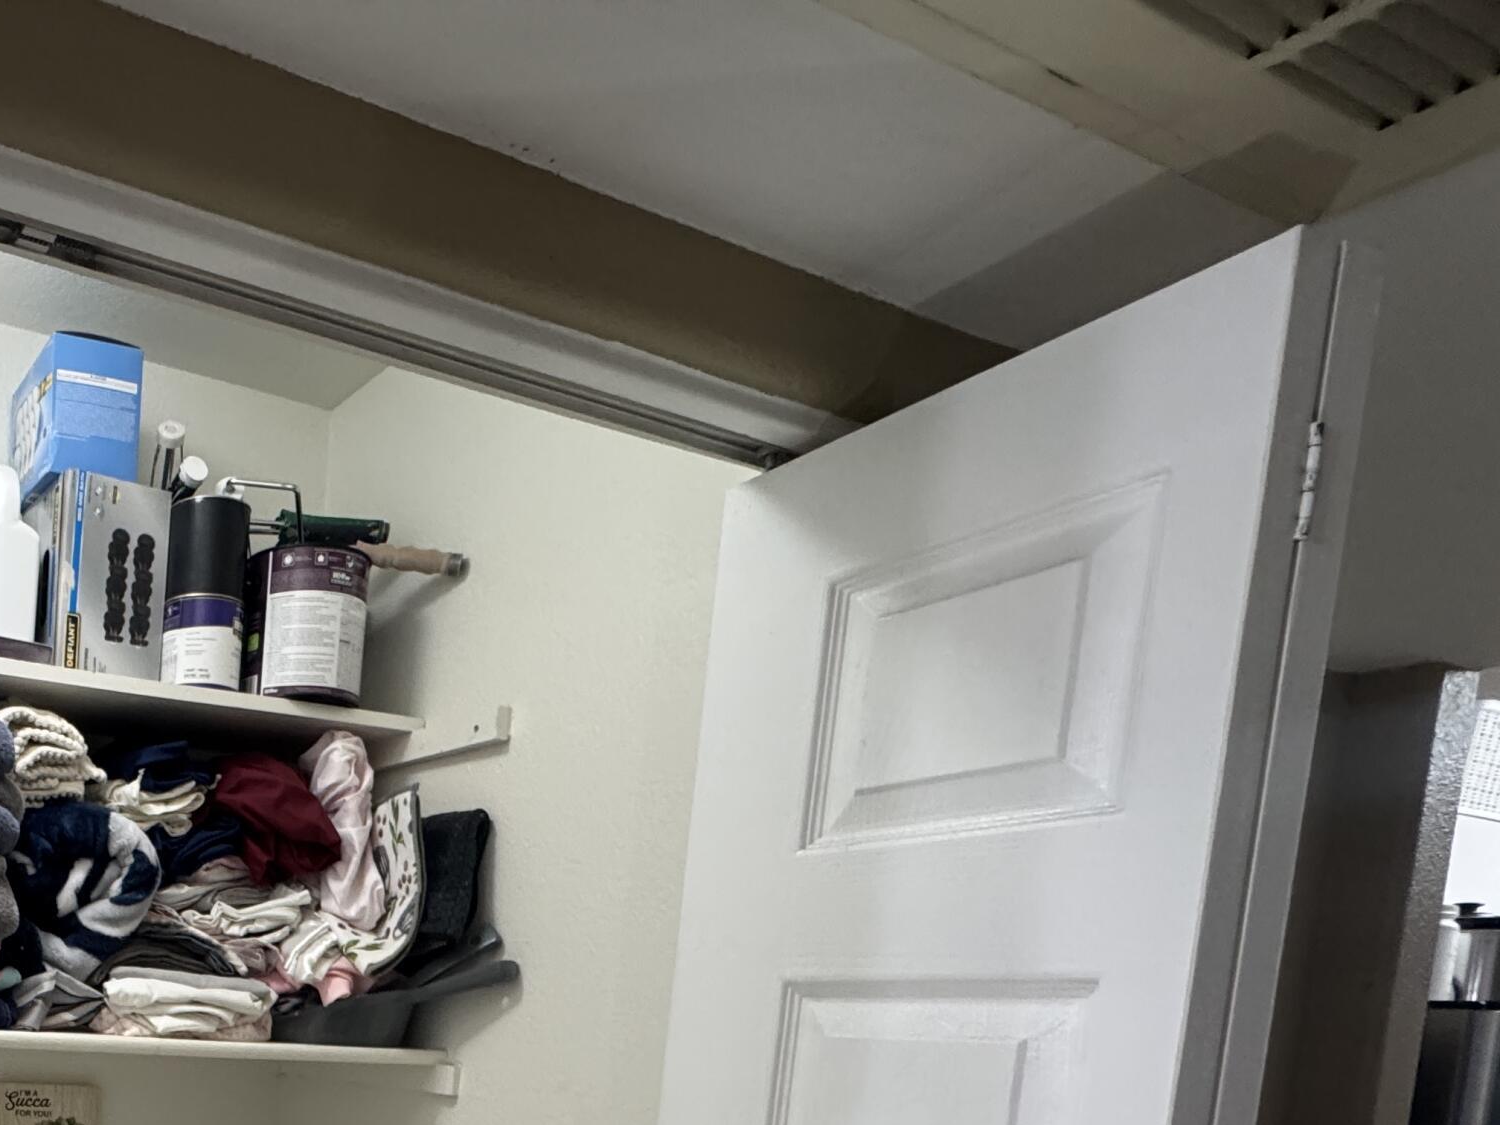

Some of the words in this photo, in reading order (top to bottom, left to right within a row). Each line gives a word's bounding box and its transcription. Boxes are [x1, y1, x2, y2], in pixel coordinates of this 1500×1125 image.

[20, 1089, 31, 1097] I'M
[32, 1089, 38, 1097] A
[5, 1091, 51, 1111] Succa
